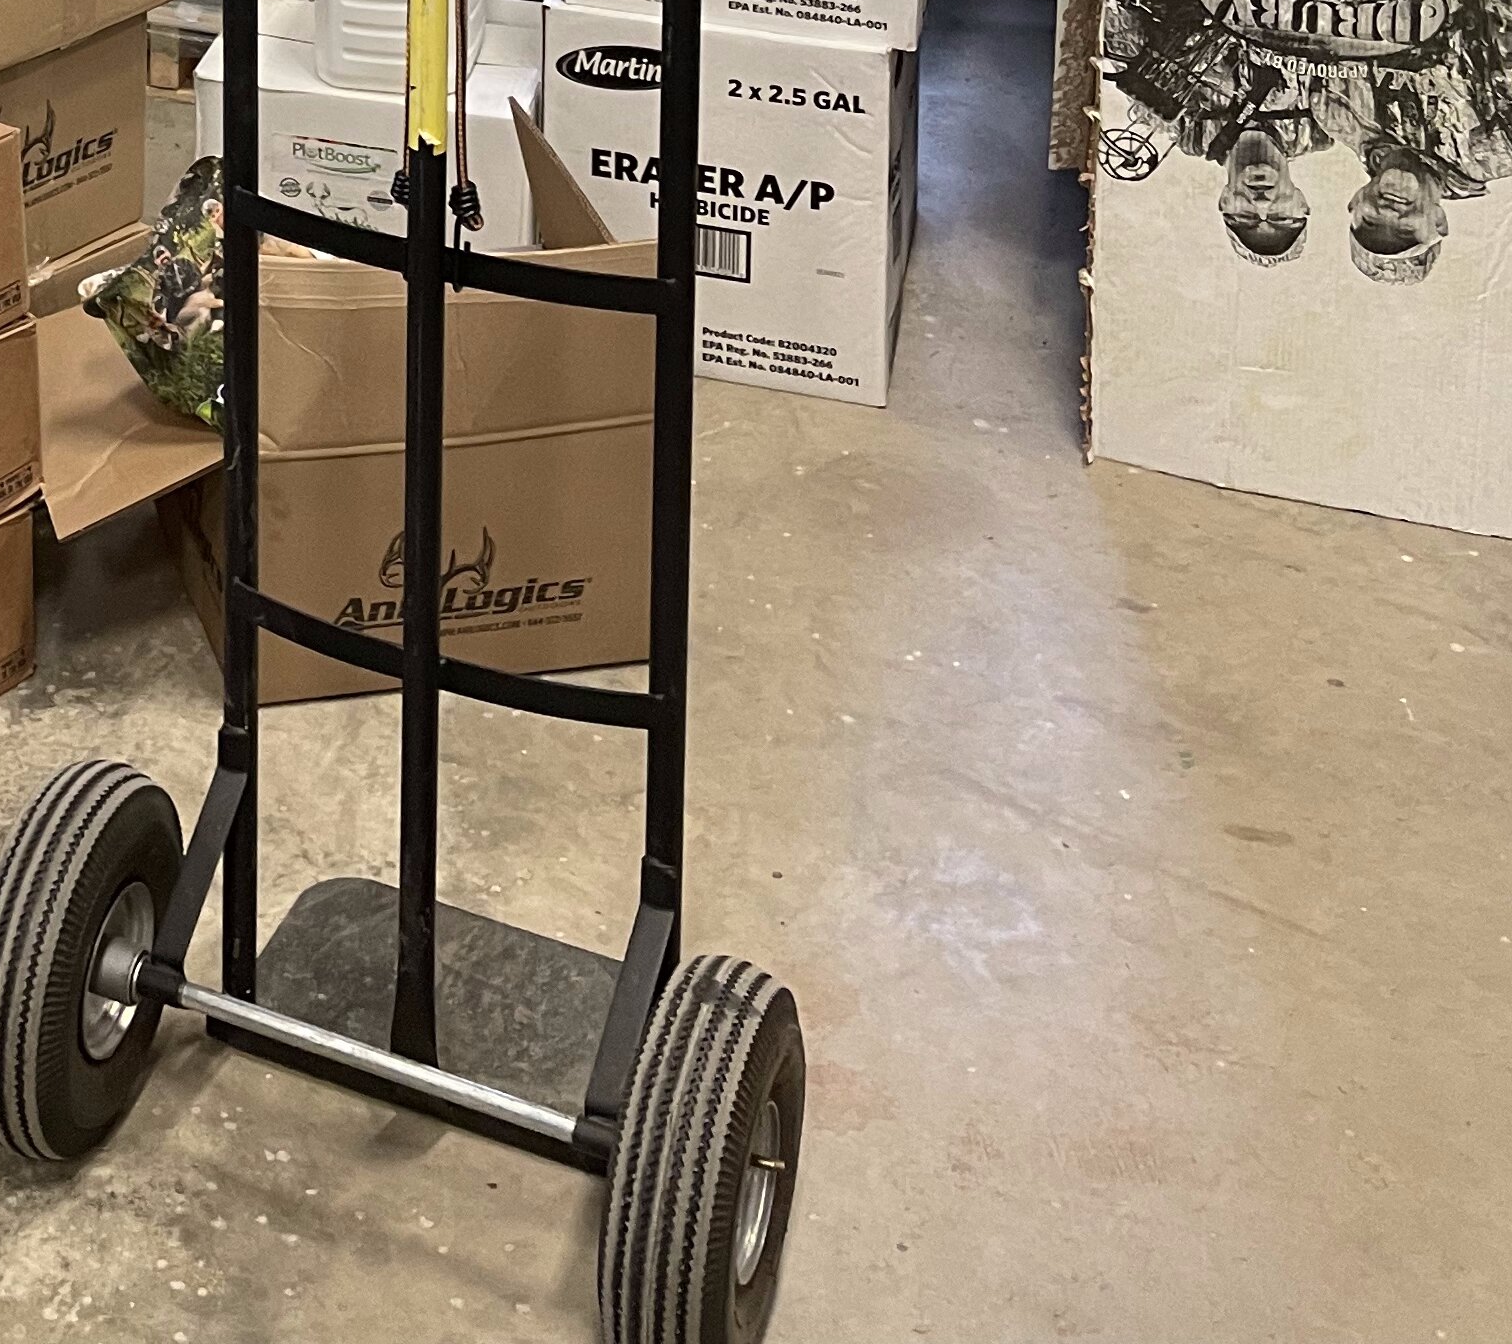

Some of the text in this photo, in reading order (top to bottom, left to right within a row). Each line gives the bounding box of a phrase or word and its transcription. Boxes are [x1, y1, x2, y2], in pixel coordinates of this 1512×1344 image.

[728, 1, 751, 12] EPA
[1286, 56, 1369, 78] APPROVED
[728, 79, 867, 114] 2 x 2.5 GAL
[591, 148, 836, 211] ERAER A/P
[650, 192, 770, 226] HBICIDE
[702, 326, 744, 342] Product
[746, 334, 776, 347] Code:
[702, 340, 724, 351] EPA
[702, 353, 724, 364] EPA
[442, 577, 586, 615] Logics
